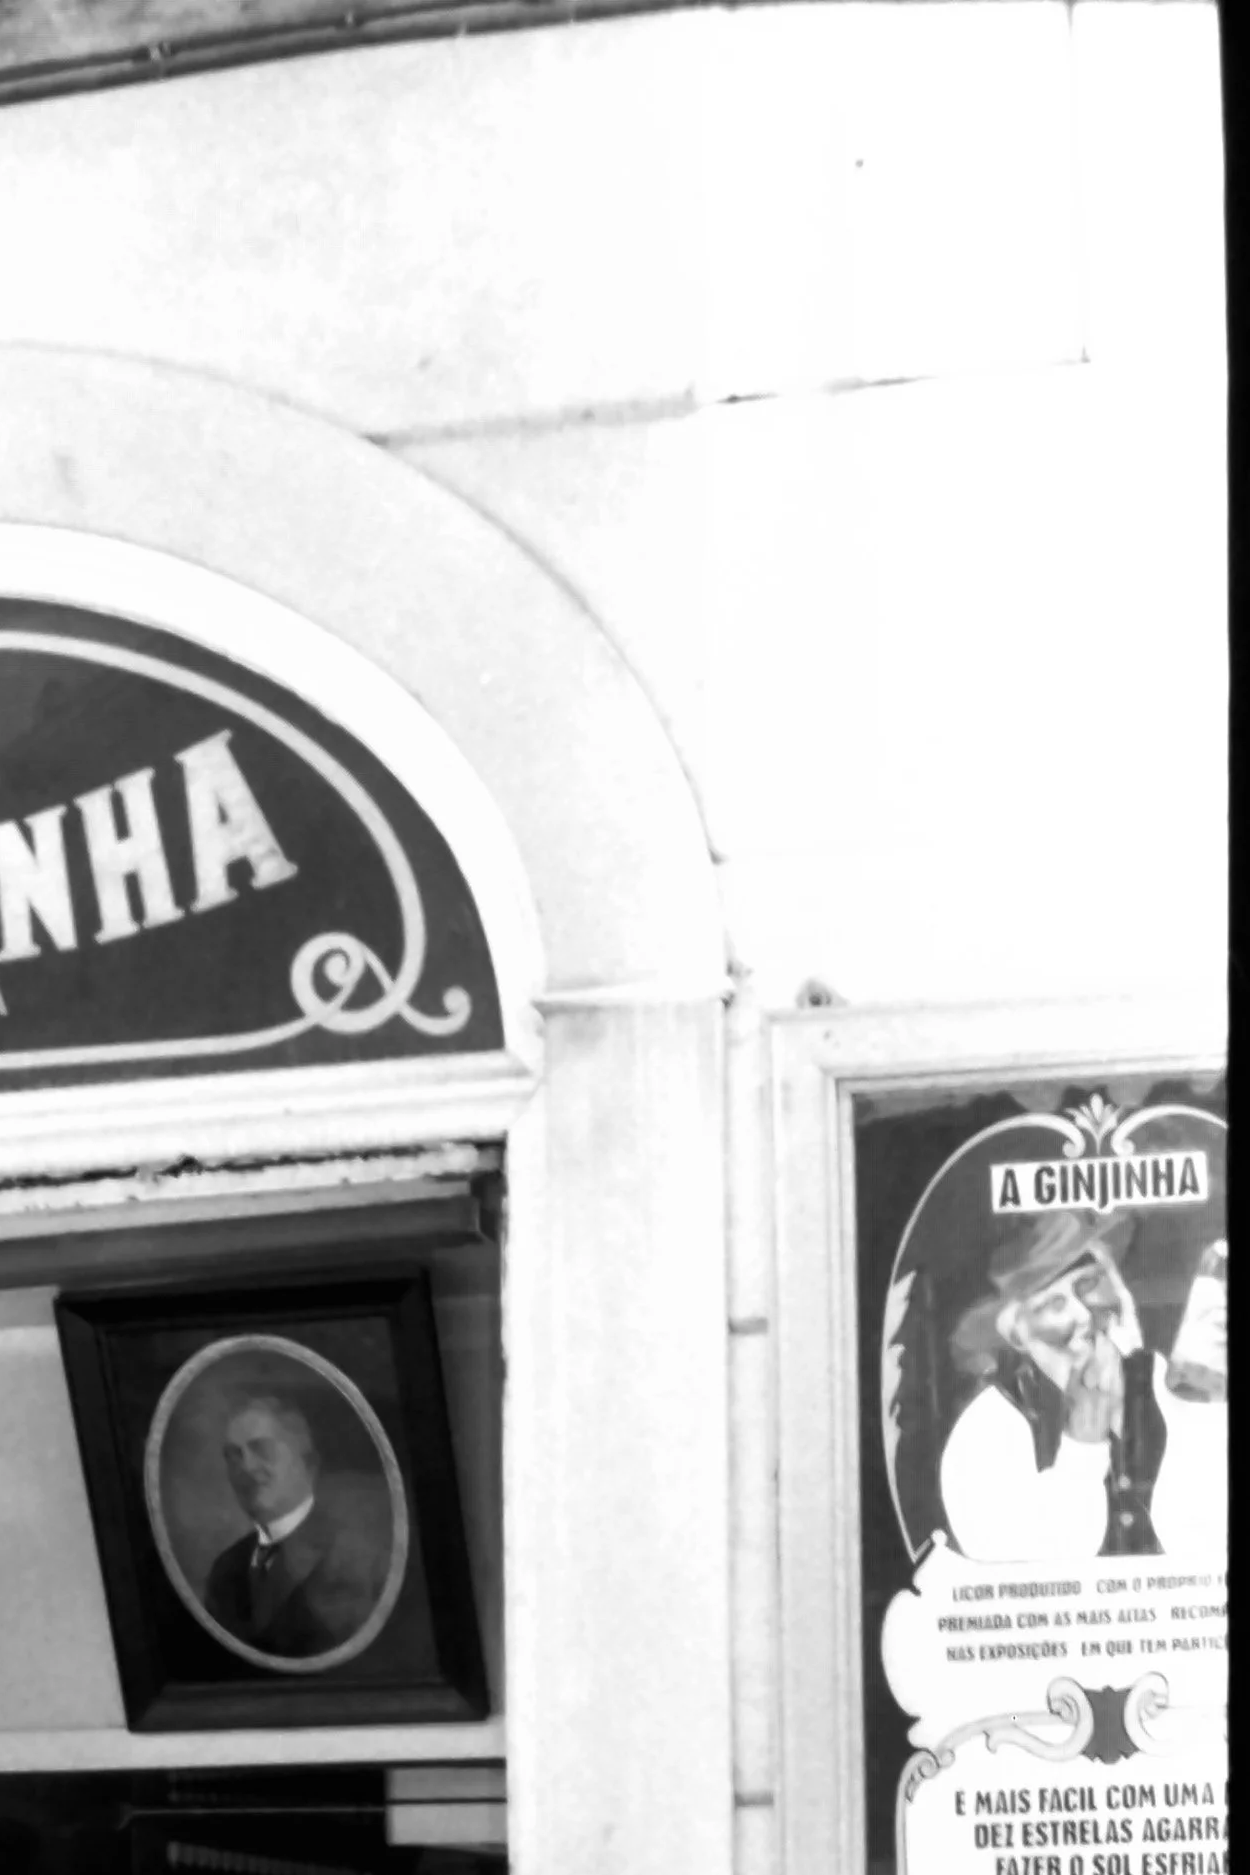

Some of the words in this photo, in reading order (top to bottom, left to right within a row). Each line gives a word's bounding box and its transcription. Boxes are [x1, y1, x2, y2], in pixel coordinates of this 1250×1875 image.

[999, 1168, 1021, 1208] A
[1034, 1156, 1201, 1208] GINJINHA
[1096, 1578, 1127, 1594] COM
[938, 1614, 1013, 1633] PREMIADA
[1016, 1612, 1049, 1629] COM
[1054, 1611, 1072, 1626] AS
[1076, 1609, 1112, 1625] MAIS
[946, 1645, 975, 1662] NAS
[1081, 1641, 1101, 1657] EM
[1105, 1640, 1133, 1658] QUE
[975, 1788, 1031, 1815] MAIS
[1038, 1786, 1097, 1813] FACIL
[1106, 1784, 1156, 1810] COM
[1164, 1782, 1215, 1807] UMA
[1022, 1818, 1133, 1847] ESTRELAS
